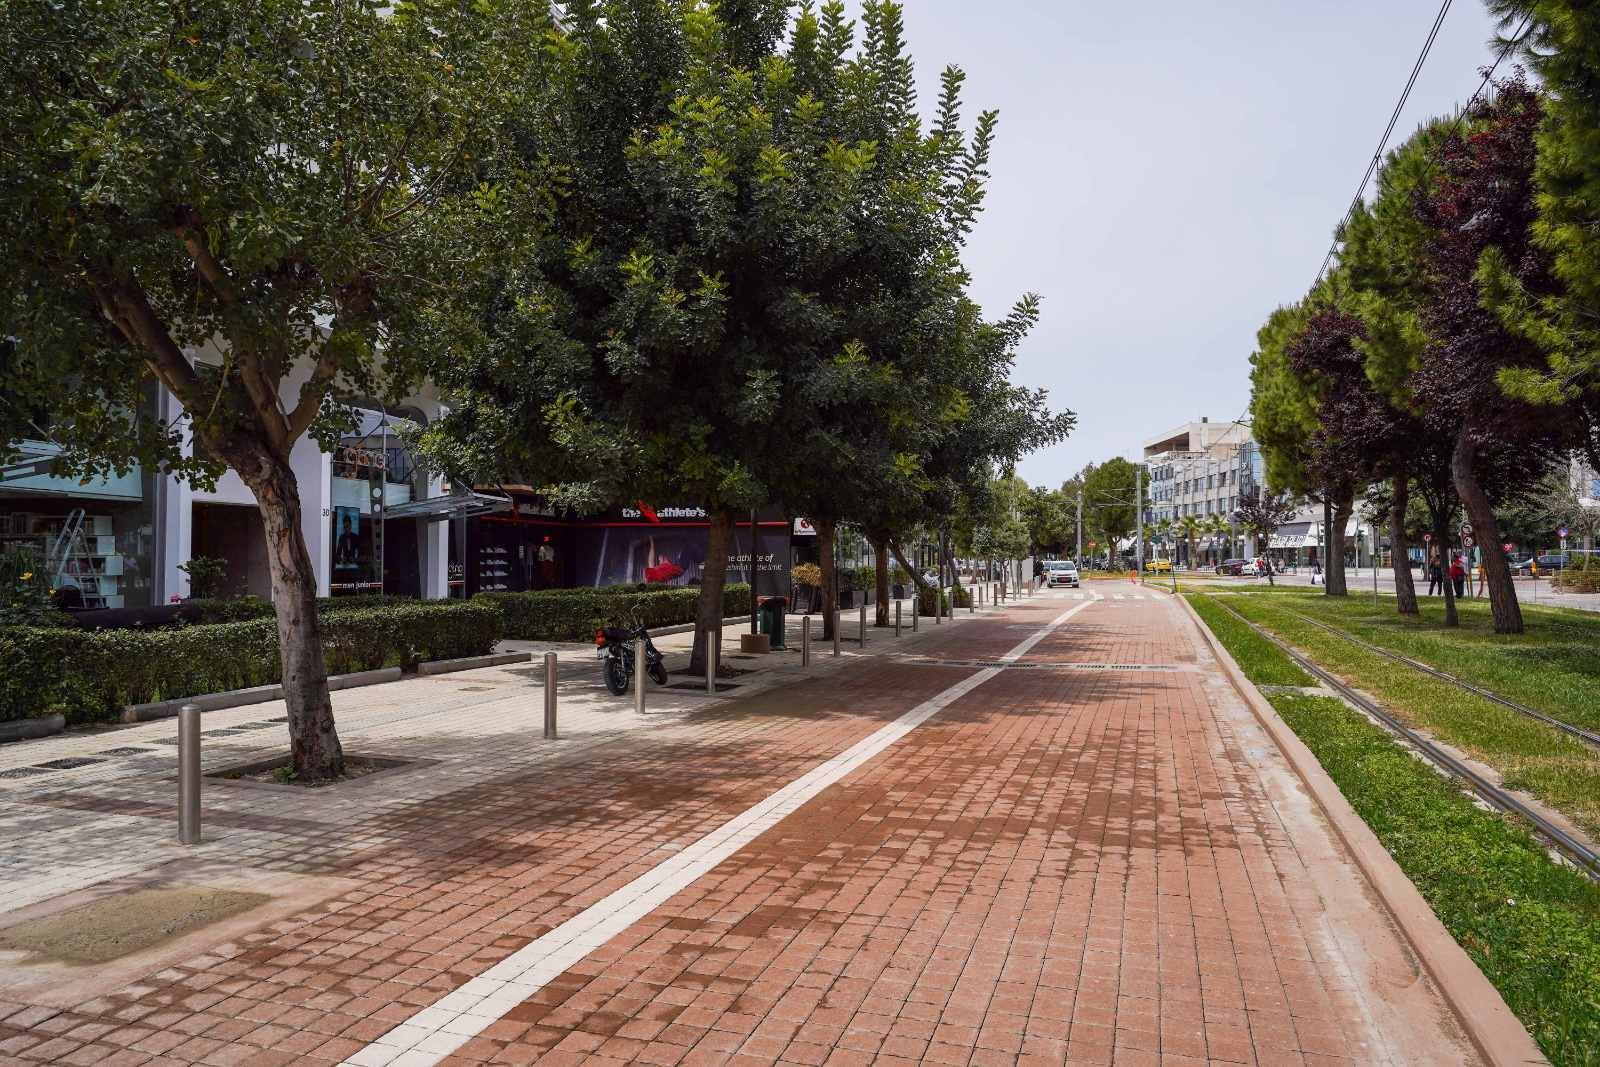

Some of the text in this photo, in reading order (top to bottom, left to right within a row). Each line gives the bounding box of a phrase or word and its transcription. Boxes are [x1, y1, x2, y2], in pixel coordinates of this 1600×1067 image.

[322, 508, 330, 517] 30
[622, 507, 706, 518] the athlete's
[764, 553, 775, 563] of
